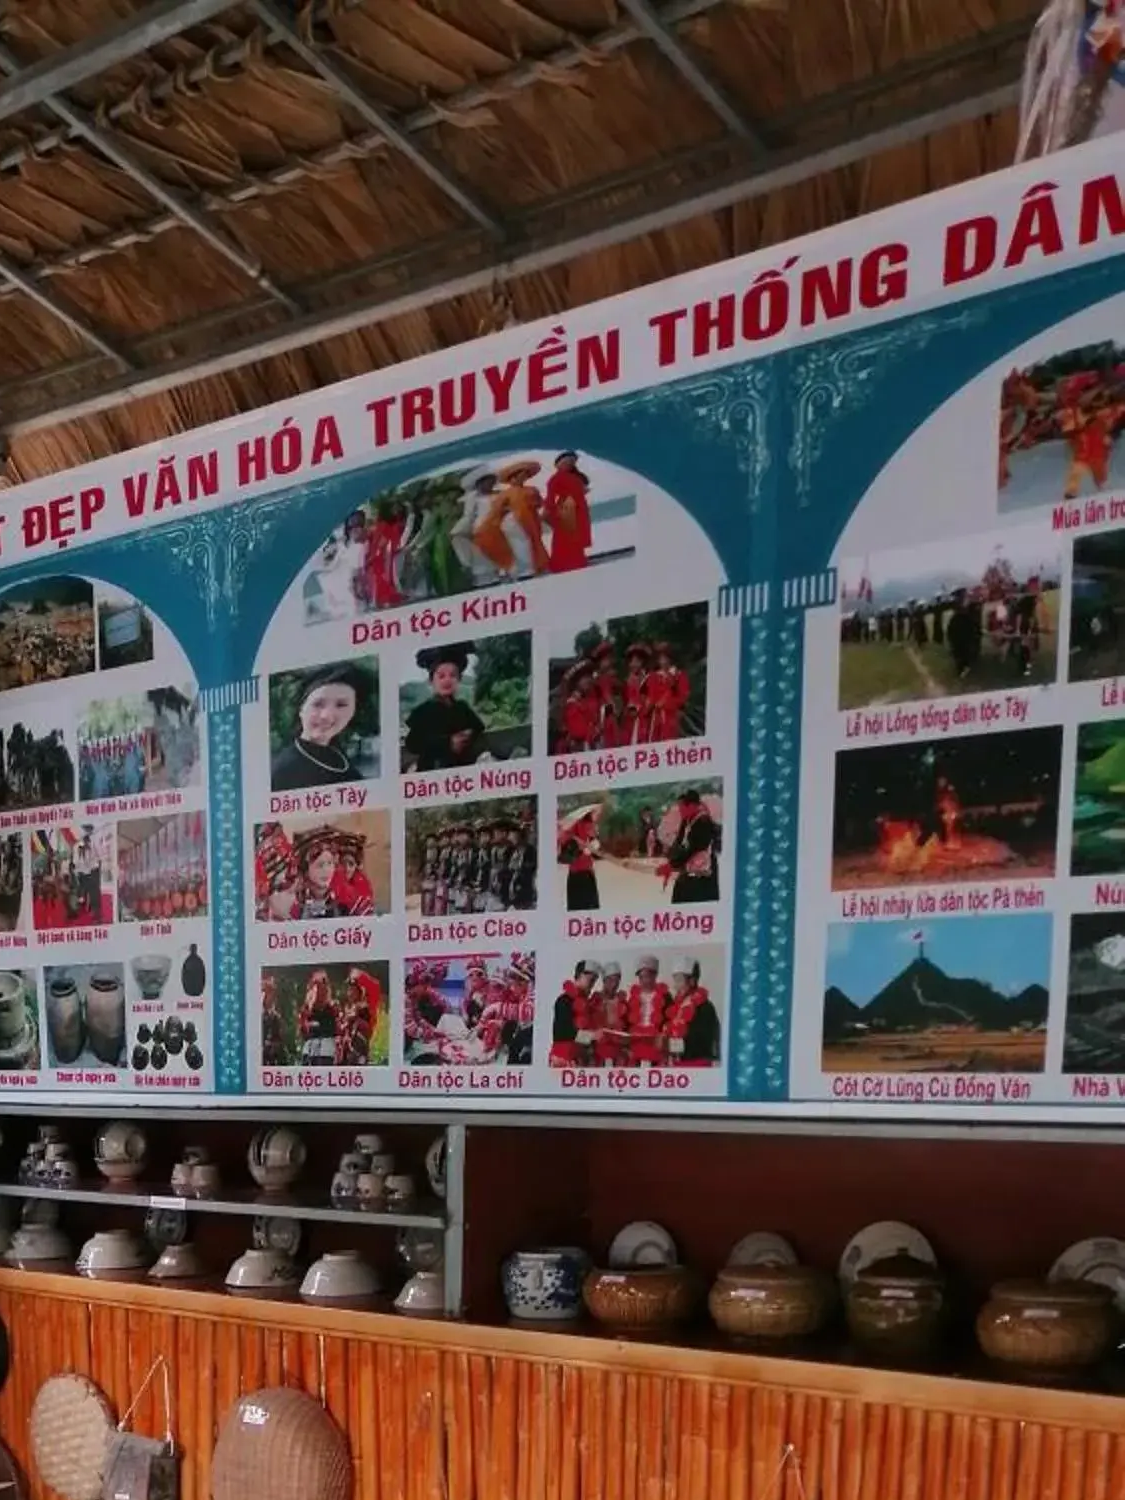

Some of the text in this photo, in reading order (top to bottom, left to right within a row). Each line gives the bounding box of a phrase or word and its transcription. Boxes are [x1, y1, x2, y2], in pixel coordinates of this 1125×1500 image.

[22, 486, 106, 549] ĐẸP
[123, 450, 219, 517] VĂN
[237, 414, 344, 486] HÓA
[365, 323, 621, 447] TRUYỀN
[648, 241, 910, 368] THỐNG
[942, 174, 1125, 286] DÂN
[352, 592, 527, 645] Dân tộc Kinh
[554, 759, 591, 781] Dân
[597, 754, 628, 779] tộc
[404, 779, 439, 799] Dân
[445, 775, 474, 798] tộc
[270, 786, 367, 813] Dân tộc Tày
[408, 923, 443, 942] Dân
[449, 921, 477, 944] tộc
[568, 911, 714, 940] Dân tộc Mông
[268, 932, 298, 949] Dân
[303, 929, 328, 951] tộc
[263, 1071, 293, 1087] Dân
[298, 1071, 323, 1091] tộc
[398, 1070, 523, 1093] Dân tộc La chí
[562, 1069, 690, 1093] Dân tộc Dao
